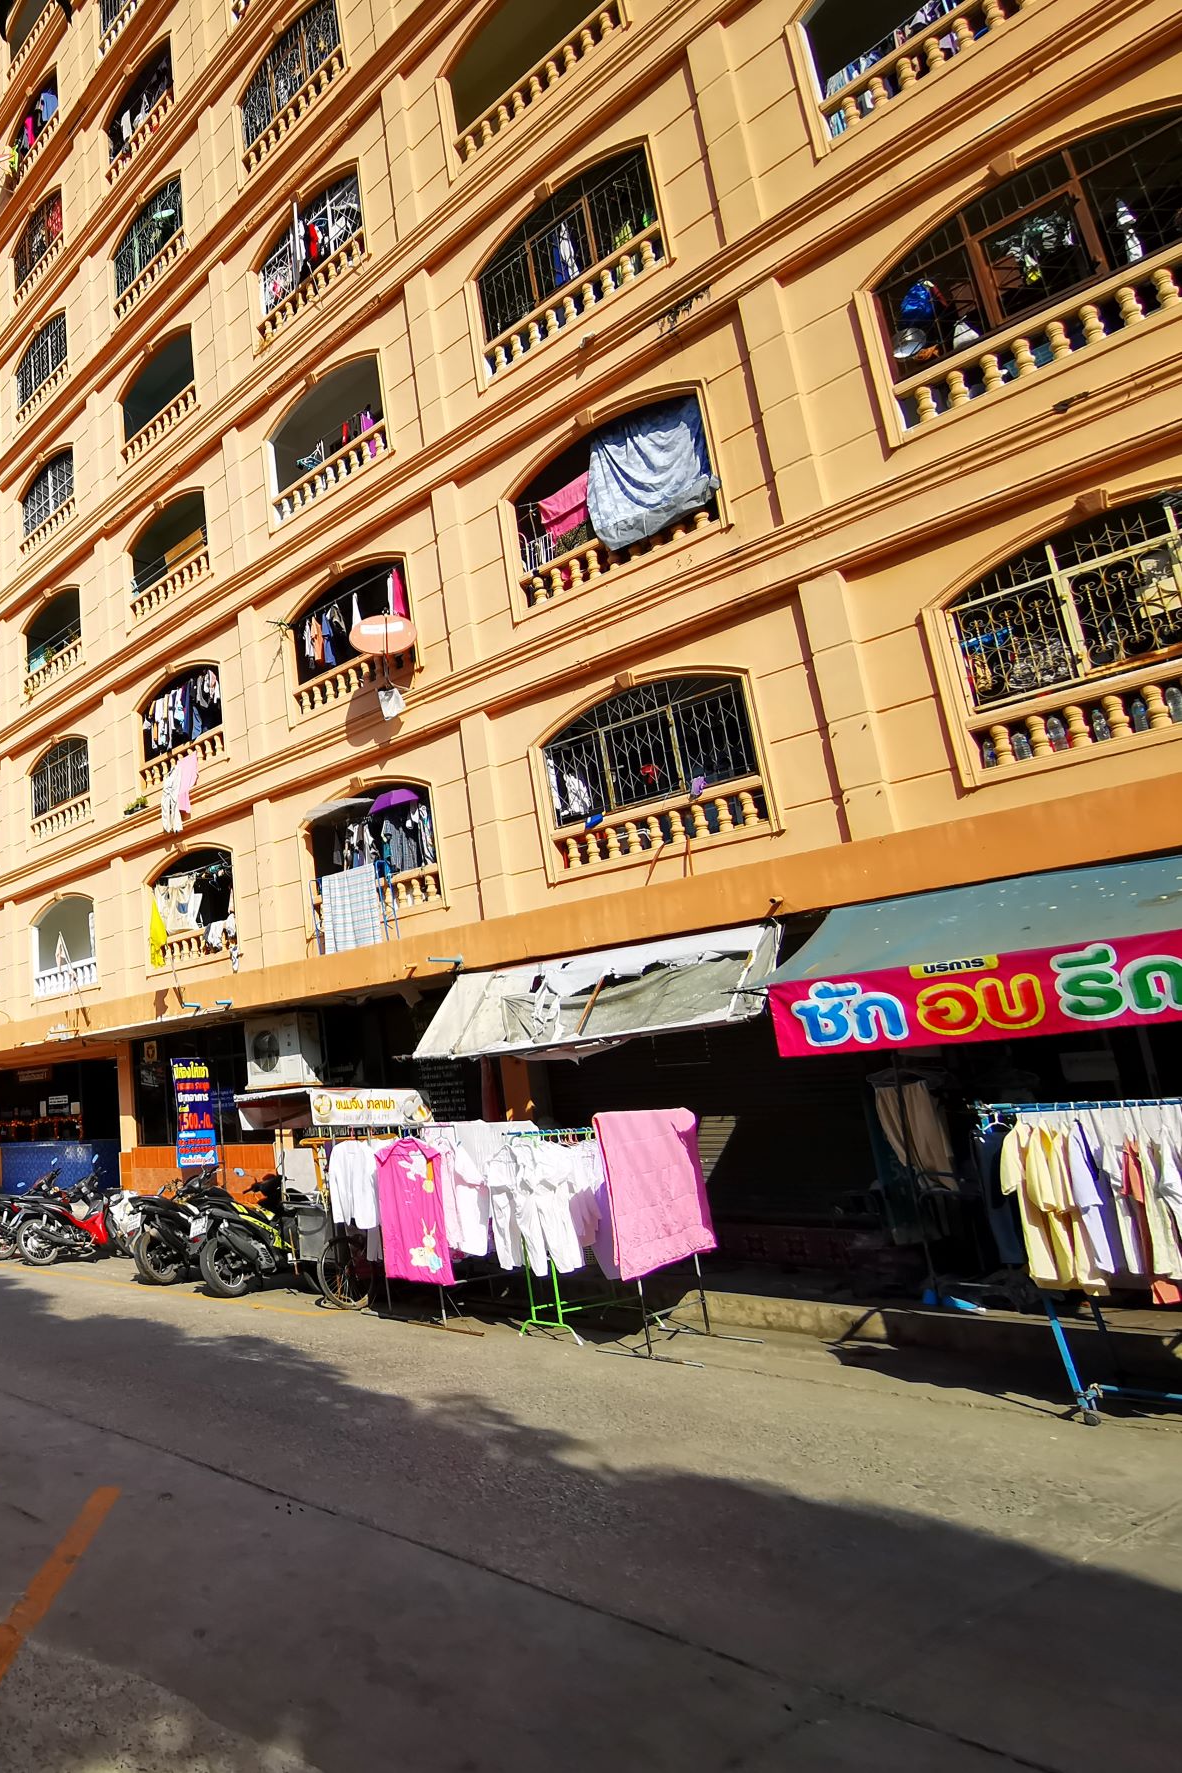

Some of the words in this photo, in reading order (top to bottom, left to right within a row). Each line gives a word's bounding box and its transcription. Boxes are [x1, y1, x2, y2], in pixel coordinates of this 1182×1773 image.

[919, 975, 1043, 1033] อบ
[1052, 945, 1182, 1018] รีด
[922, 957, 986, 974] บริการ
